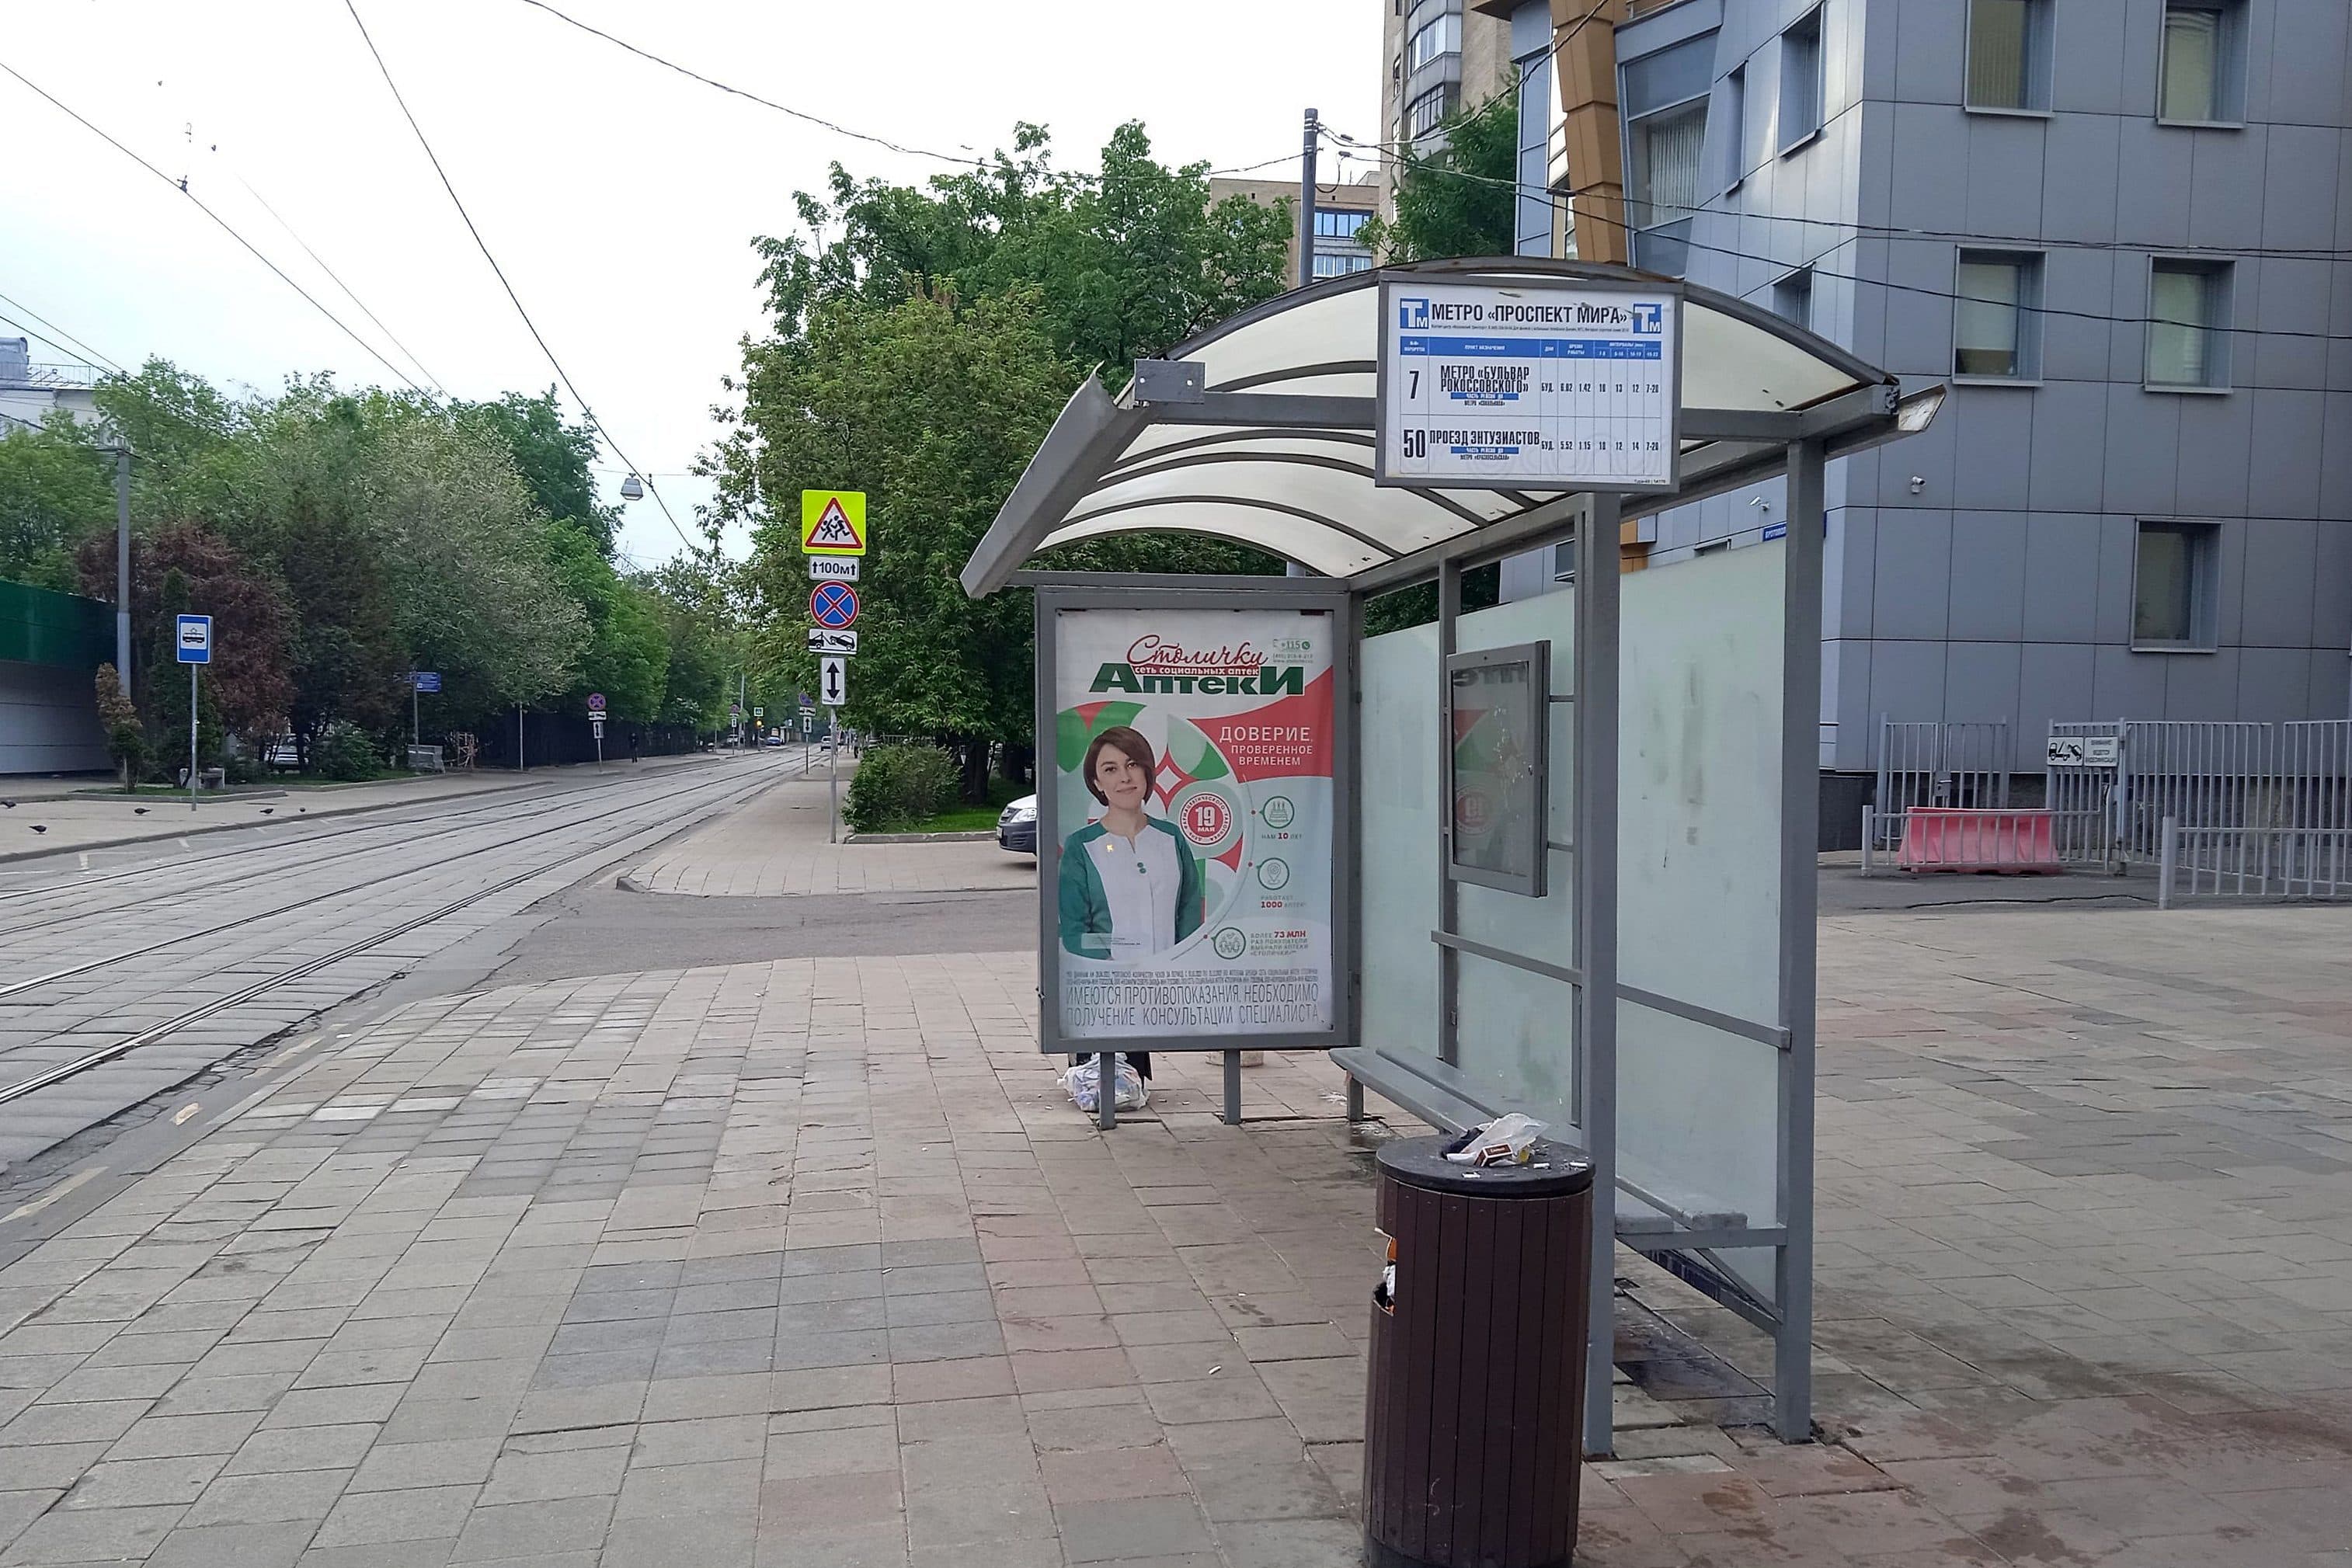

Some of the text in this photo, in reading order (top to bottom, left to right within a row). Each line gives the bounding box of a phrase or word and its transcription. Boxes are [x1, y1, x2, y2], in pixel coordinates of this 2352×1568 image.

[1432, 304, 1627, 323] МЕТРО «ПРОСПЕКТ МИРА»
[1441, 365, 1529, 380] МЕТРО «БУЛЬВАР
[1409, 370, 1419, 399] 7
[1441, 379, 1529, 393] РОКОССОВСКОГО»
[1404, 429, 1425, 457] 50
[1429, 430, 1540, 446] ПРОЕЗД ЭНТУЗИАСТОВ
[1127, 635, 1268, 666] Столички
[1231, 745, 1313, 754] ПРОВЕРЕННОЕ
[1239, 756, 1300, 766] ВРЕМЕНЕМ
[1195, 806, 1216, 826] 19
[1286, 930, 1306, 938] МЛН
[1066, 986, 1121, 1004] ИМЕЮТСЯ
[1244, 982, 1318, 1004] НЕОБХОДИМО
[1066, 1003, 1318, 1027] ПОЛУЧЕНИЕ КОНСУЛЬТАЦИИ СПЕЦИАЛИСТА
